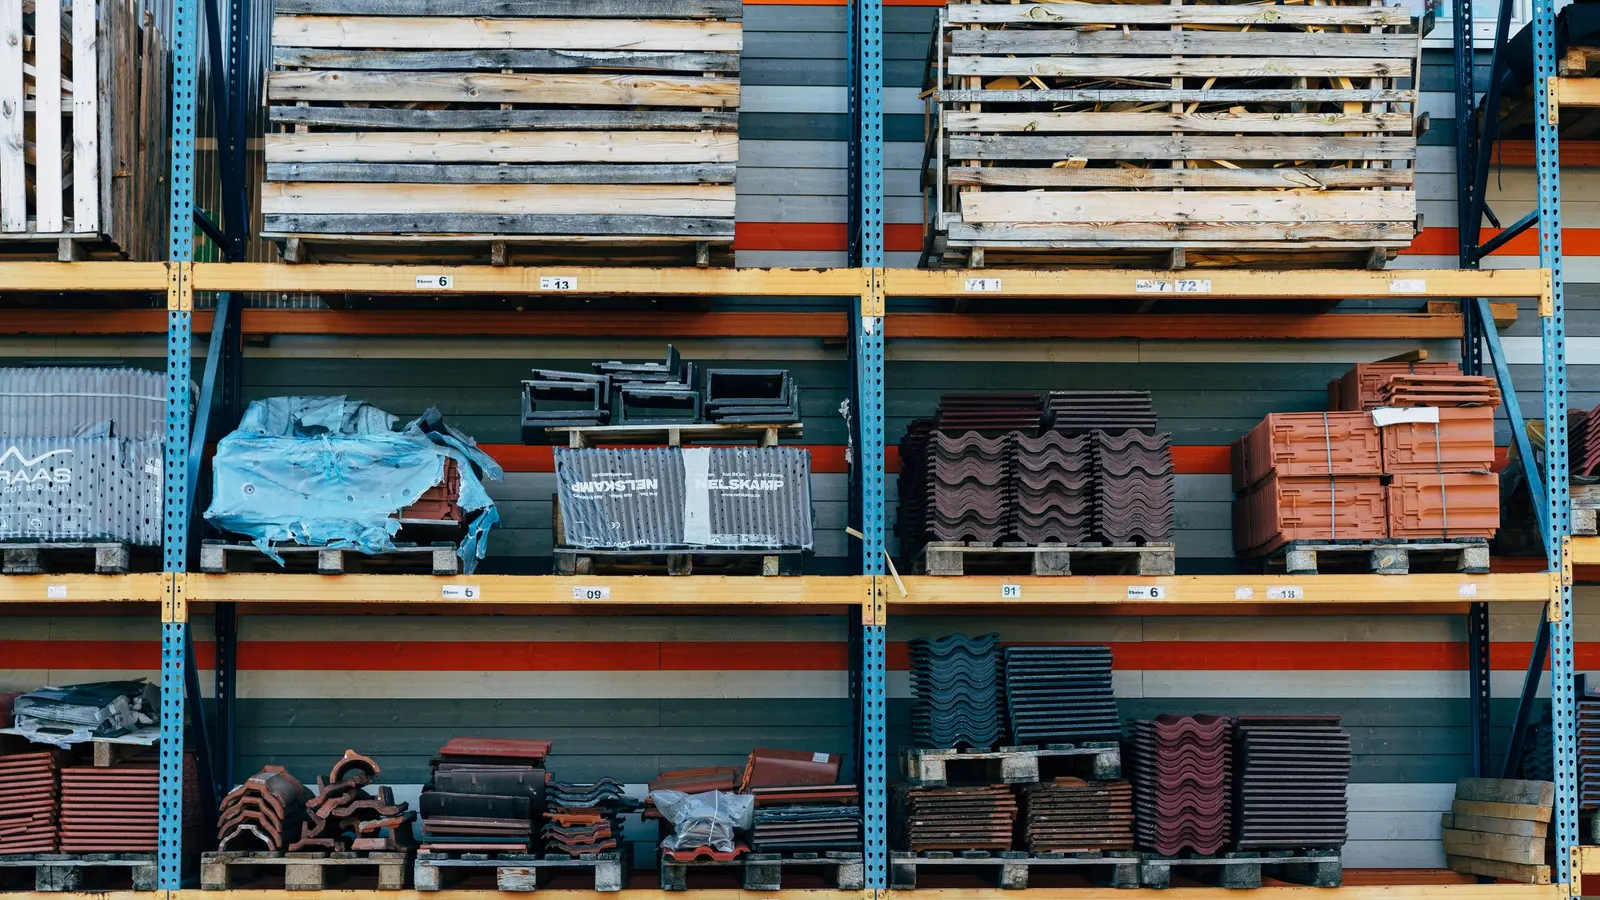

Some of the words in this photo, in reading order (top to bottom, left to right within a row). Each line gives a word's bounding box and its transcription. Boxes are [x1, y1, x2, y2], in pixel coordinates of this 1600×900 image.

[438, 276, 447, 286] 6
[554, 281, 569, 290] 13
[1178, 280, 1197, 291] 72
[1158, 282, 1166, 291] 7
[571, 478, 658, 493] NELSKAMP
[694, 478, 784, 490] NELSKAMP
[4, 486, 22, 494] GUT
[465, 587, 473, 597] 6
[587, 590, 601, 599] 09
[1004, 586, 1016, 596] 91
[1150, 587, 1159, 597] 6
